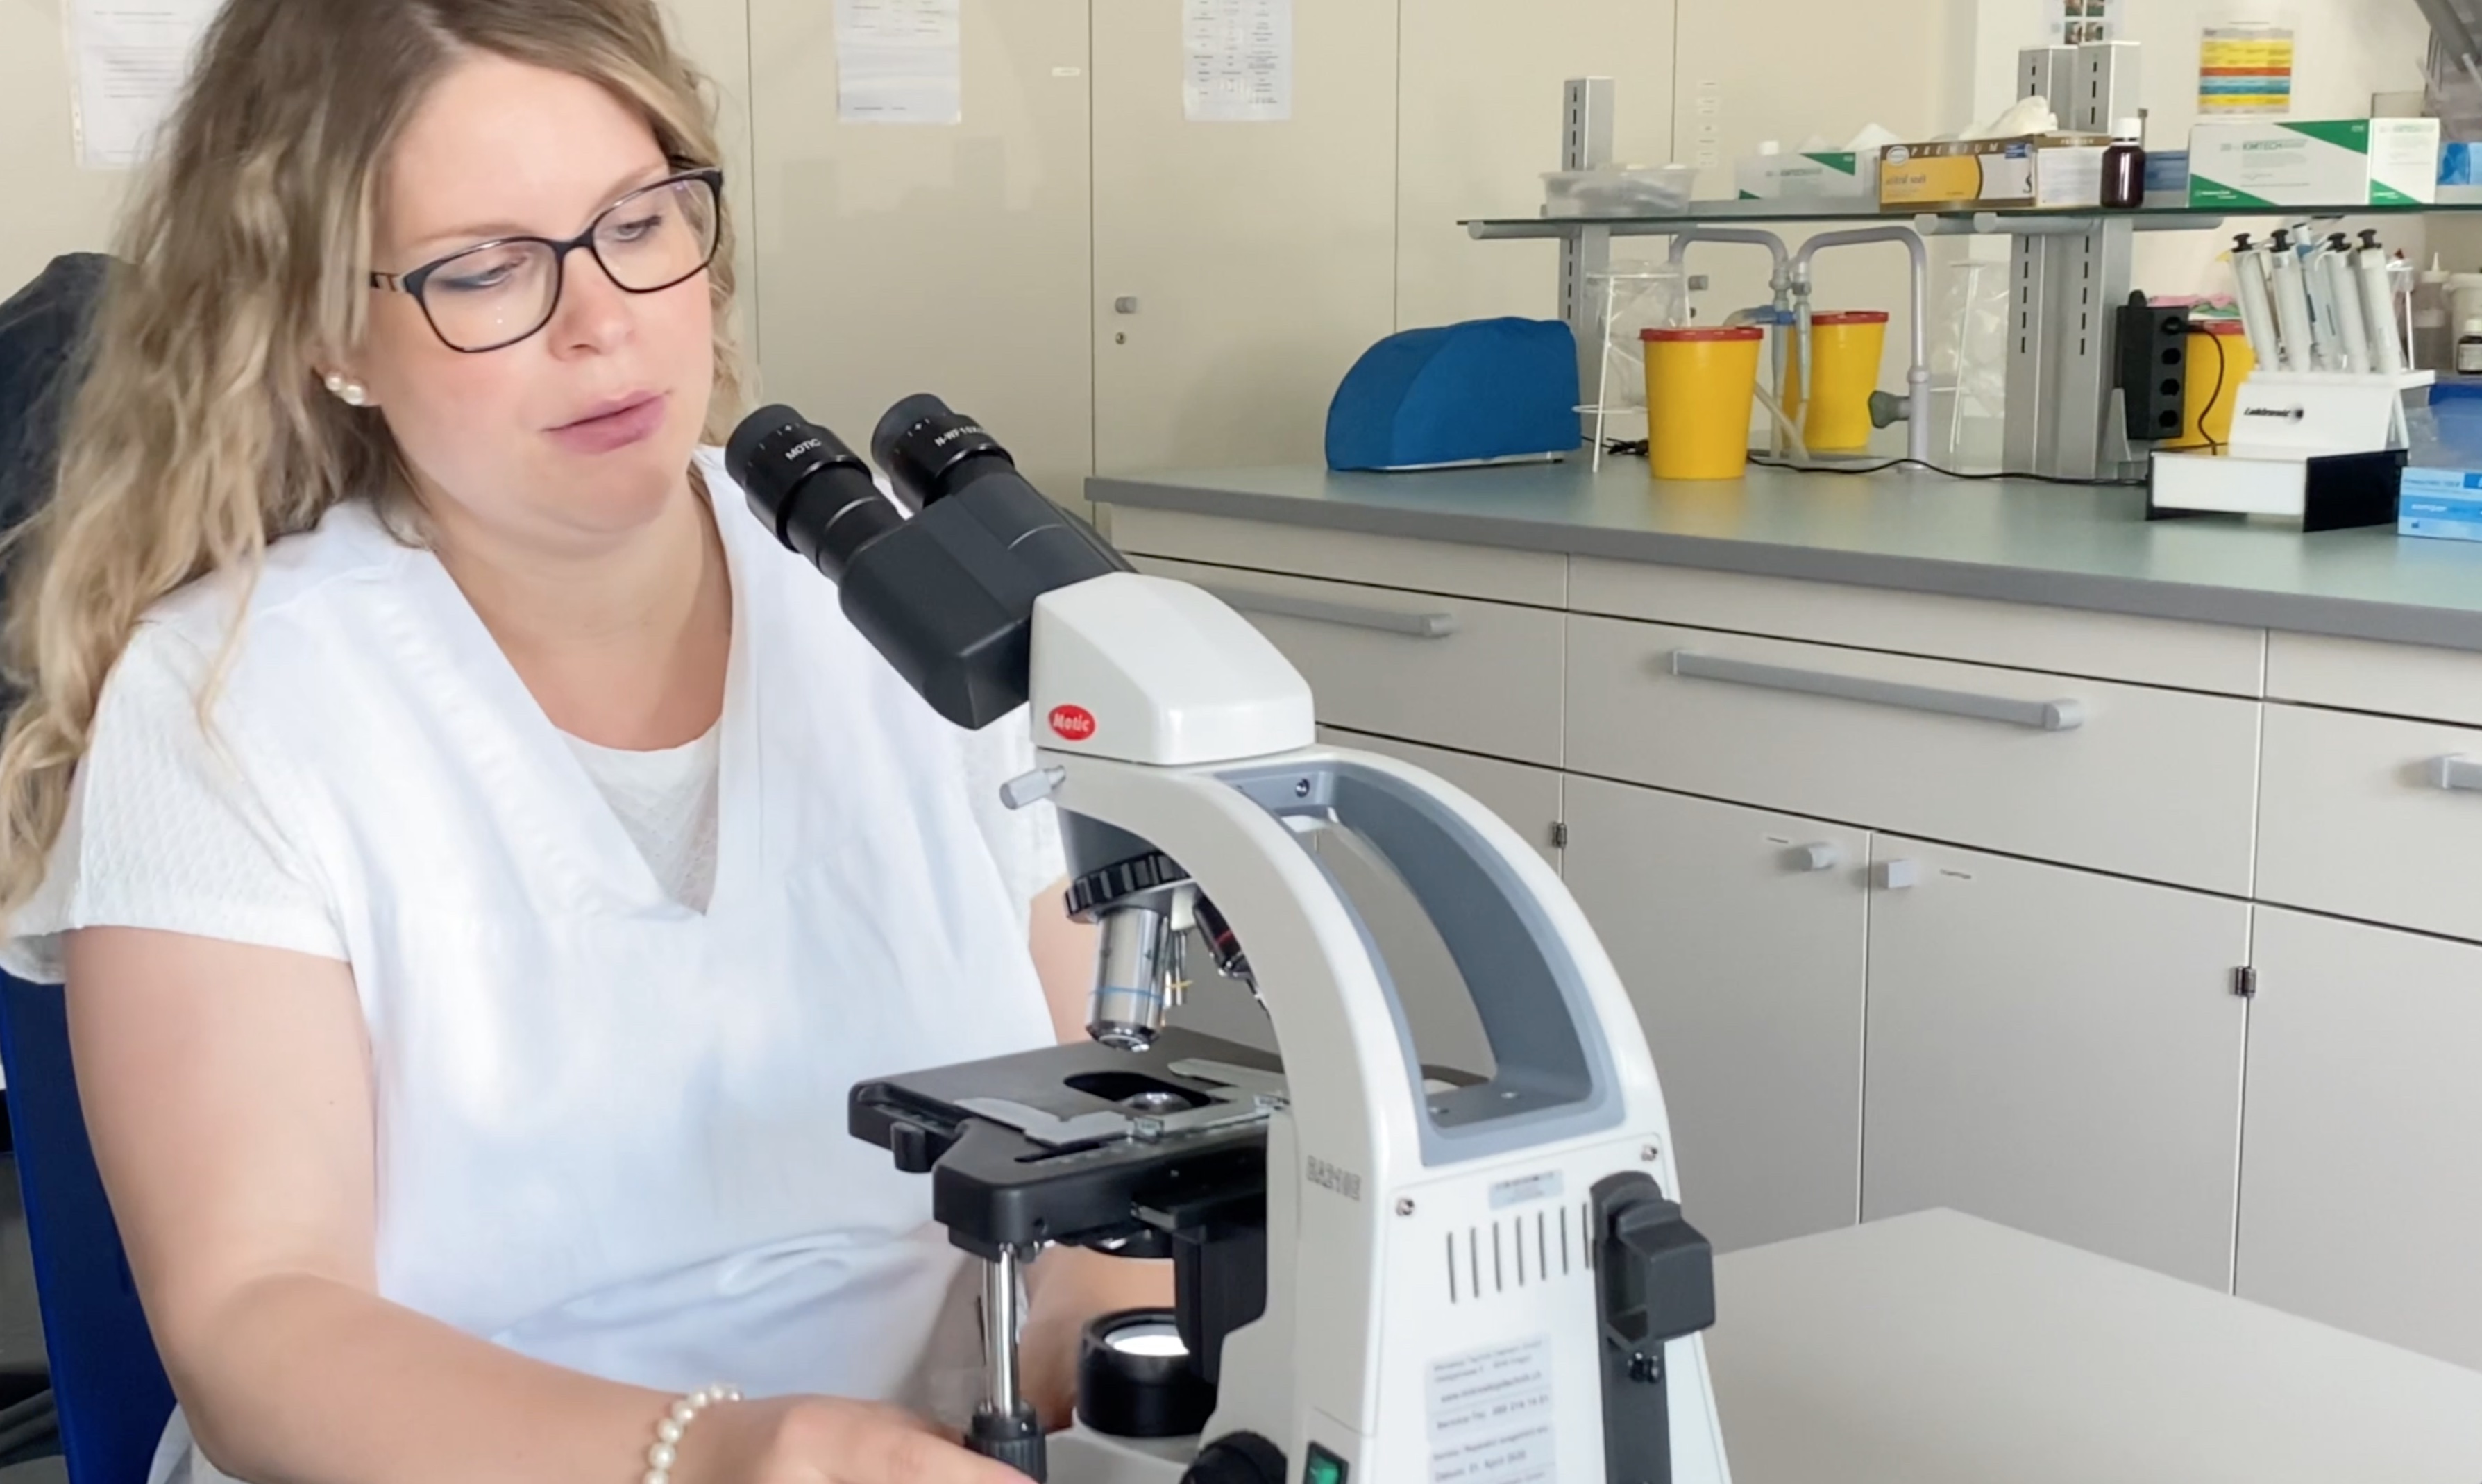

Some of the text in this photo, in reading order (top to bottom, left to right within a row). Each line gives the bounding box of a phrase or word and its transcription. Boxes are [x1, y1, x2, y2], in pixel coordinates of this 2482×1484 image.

[1911, 143, 1999, 156] PREMIUM
[2243, 142, 2283, 151] KIMTECH
[785, 438, 821, 461] MOTIC
[1053, 712, 1090, 732] Motic
